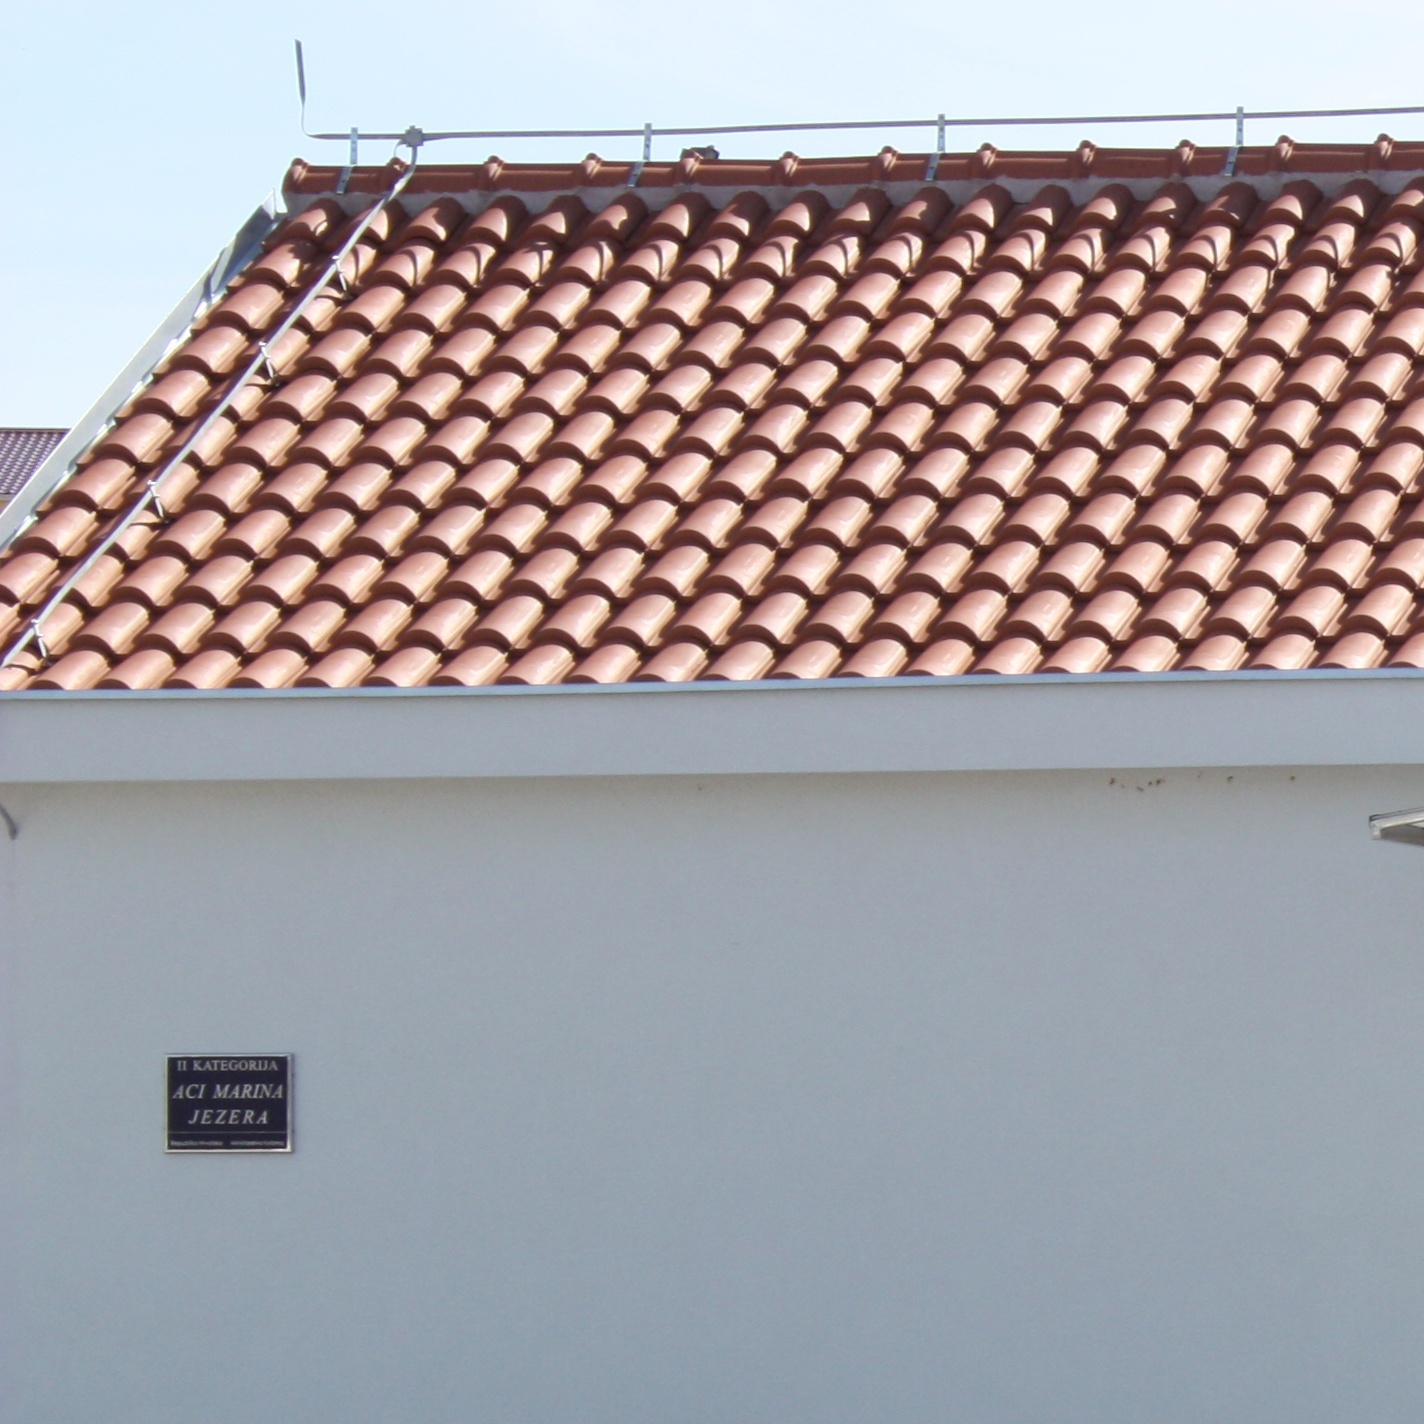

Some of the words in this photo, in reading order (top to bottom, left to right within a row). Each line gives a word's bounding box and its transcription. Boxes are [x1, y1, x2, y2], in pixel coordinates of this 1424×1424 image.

[177, 1060, 187, 1072] II
[193, 1060, 279, 1072] KATEGORIJA
[172, 1084, 206, 1099] ACI
[213, 1084, 284, 1099] MARINA
[188, 1109, 268, 1125] JEZERA
